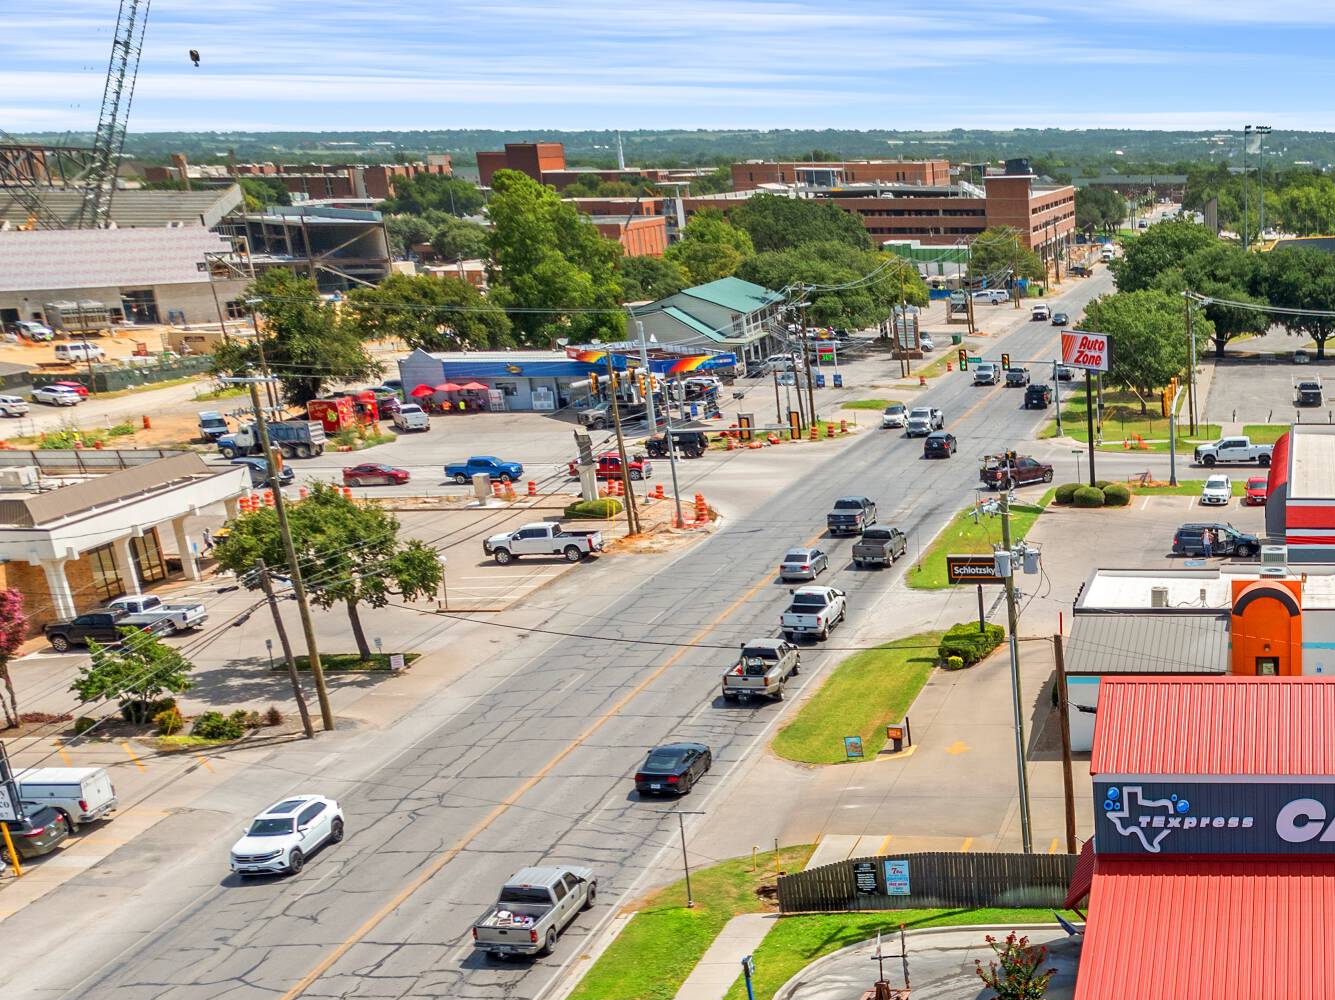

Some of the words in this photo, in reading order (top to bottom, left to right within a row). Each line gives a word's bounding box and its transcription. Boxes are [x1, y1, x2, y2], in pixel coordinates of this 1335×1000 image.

[1079, 335, 1105, 352] Auto
[1074, 350, 1102, 367] Zone
[953, 566, 996, 576] Schlotzsky
